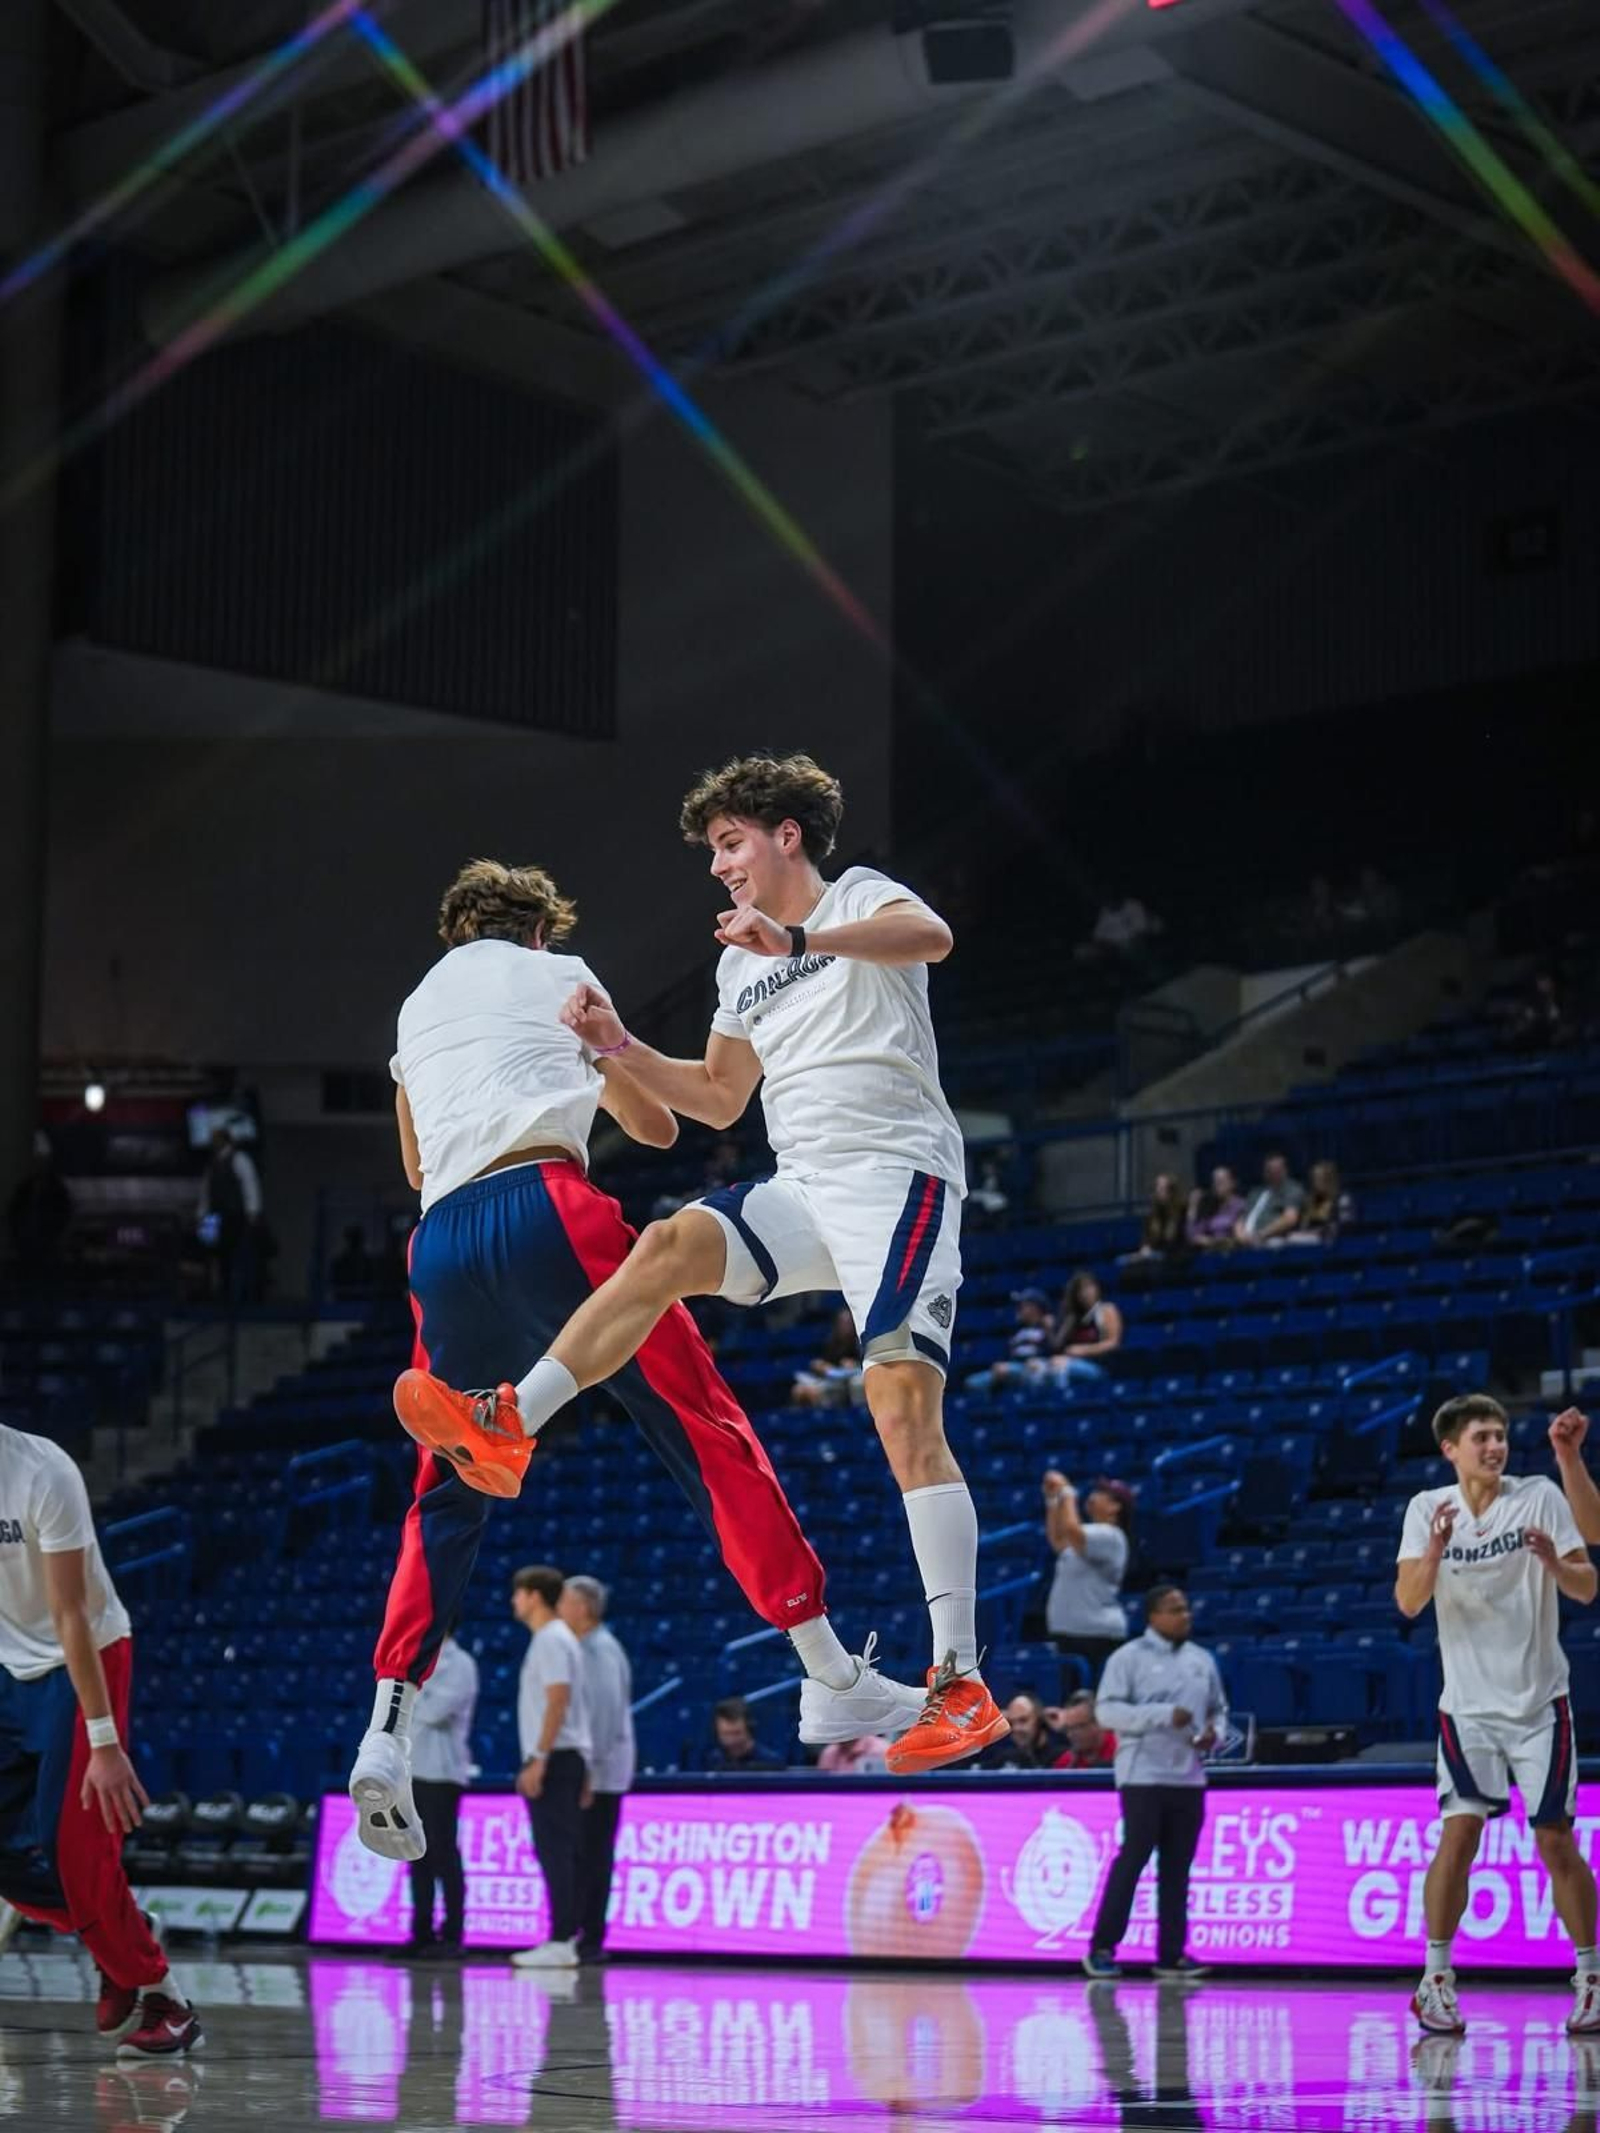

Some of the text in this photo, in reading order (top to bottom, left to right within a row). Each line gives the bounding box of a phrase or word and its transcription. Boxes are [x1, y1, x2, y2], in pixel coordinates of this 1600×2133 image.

[613, 1822, 833, 1864] ASHINGTON
[605, 1866, 816, 1930] ROWN
[1191, 1924, 1292, 1948] ONIONS
